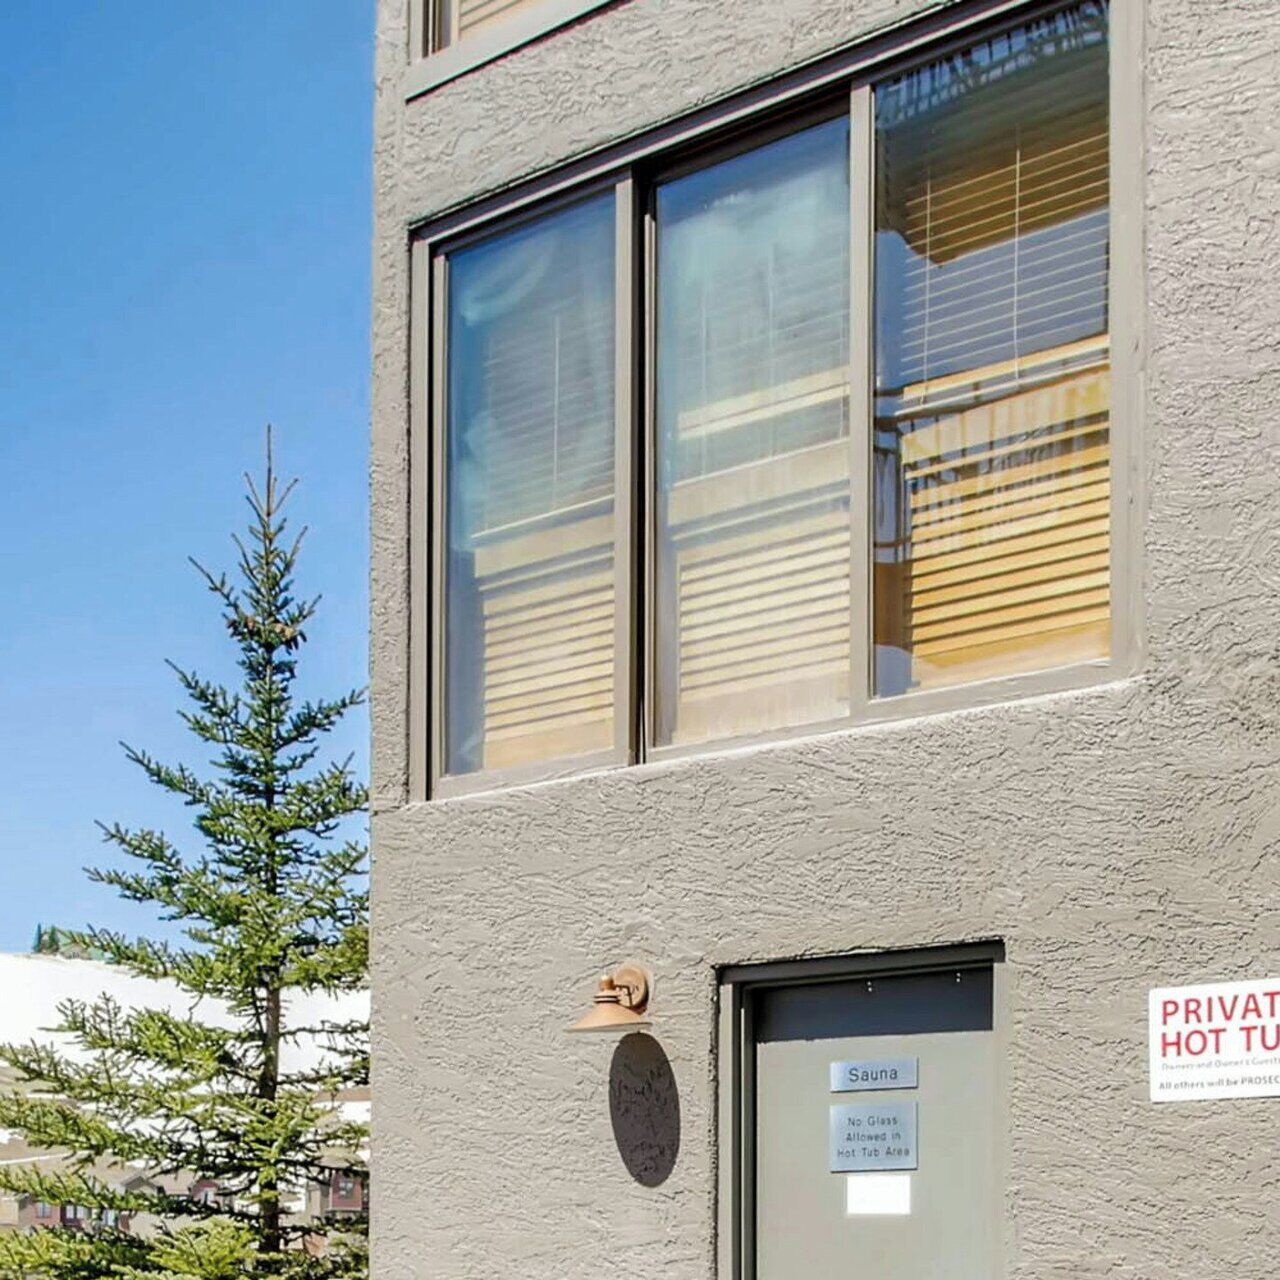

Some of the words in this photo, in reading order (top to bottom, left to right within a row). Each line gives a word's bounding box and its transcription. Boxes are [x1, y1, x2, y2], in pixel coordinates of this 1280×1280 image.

[1161, 1028, 1227, 1057] HOT
[849, 1067, 898, 1083] Sauna
[1160, 1081, 1172, 1089] All
[1174, 1081, 1205, 1089] others
[1208, 1078, 1224, 1087] will
[1226, 1078, 1238, 1086] be
[848, 1117, 861, 1127] No
[867, 1116, 898, 1126] Glass
[846, 1131, 887, 1142] Allowed
[837, 1149, 856, 1158] Hot
[862, 1147, 880, 1157] Tub
[885, 1147, 910, 1156] Area
